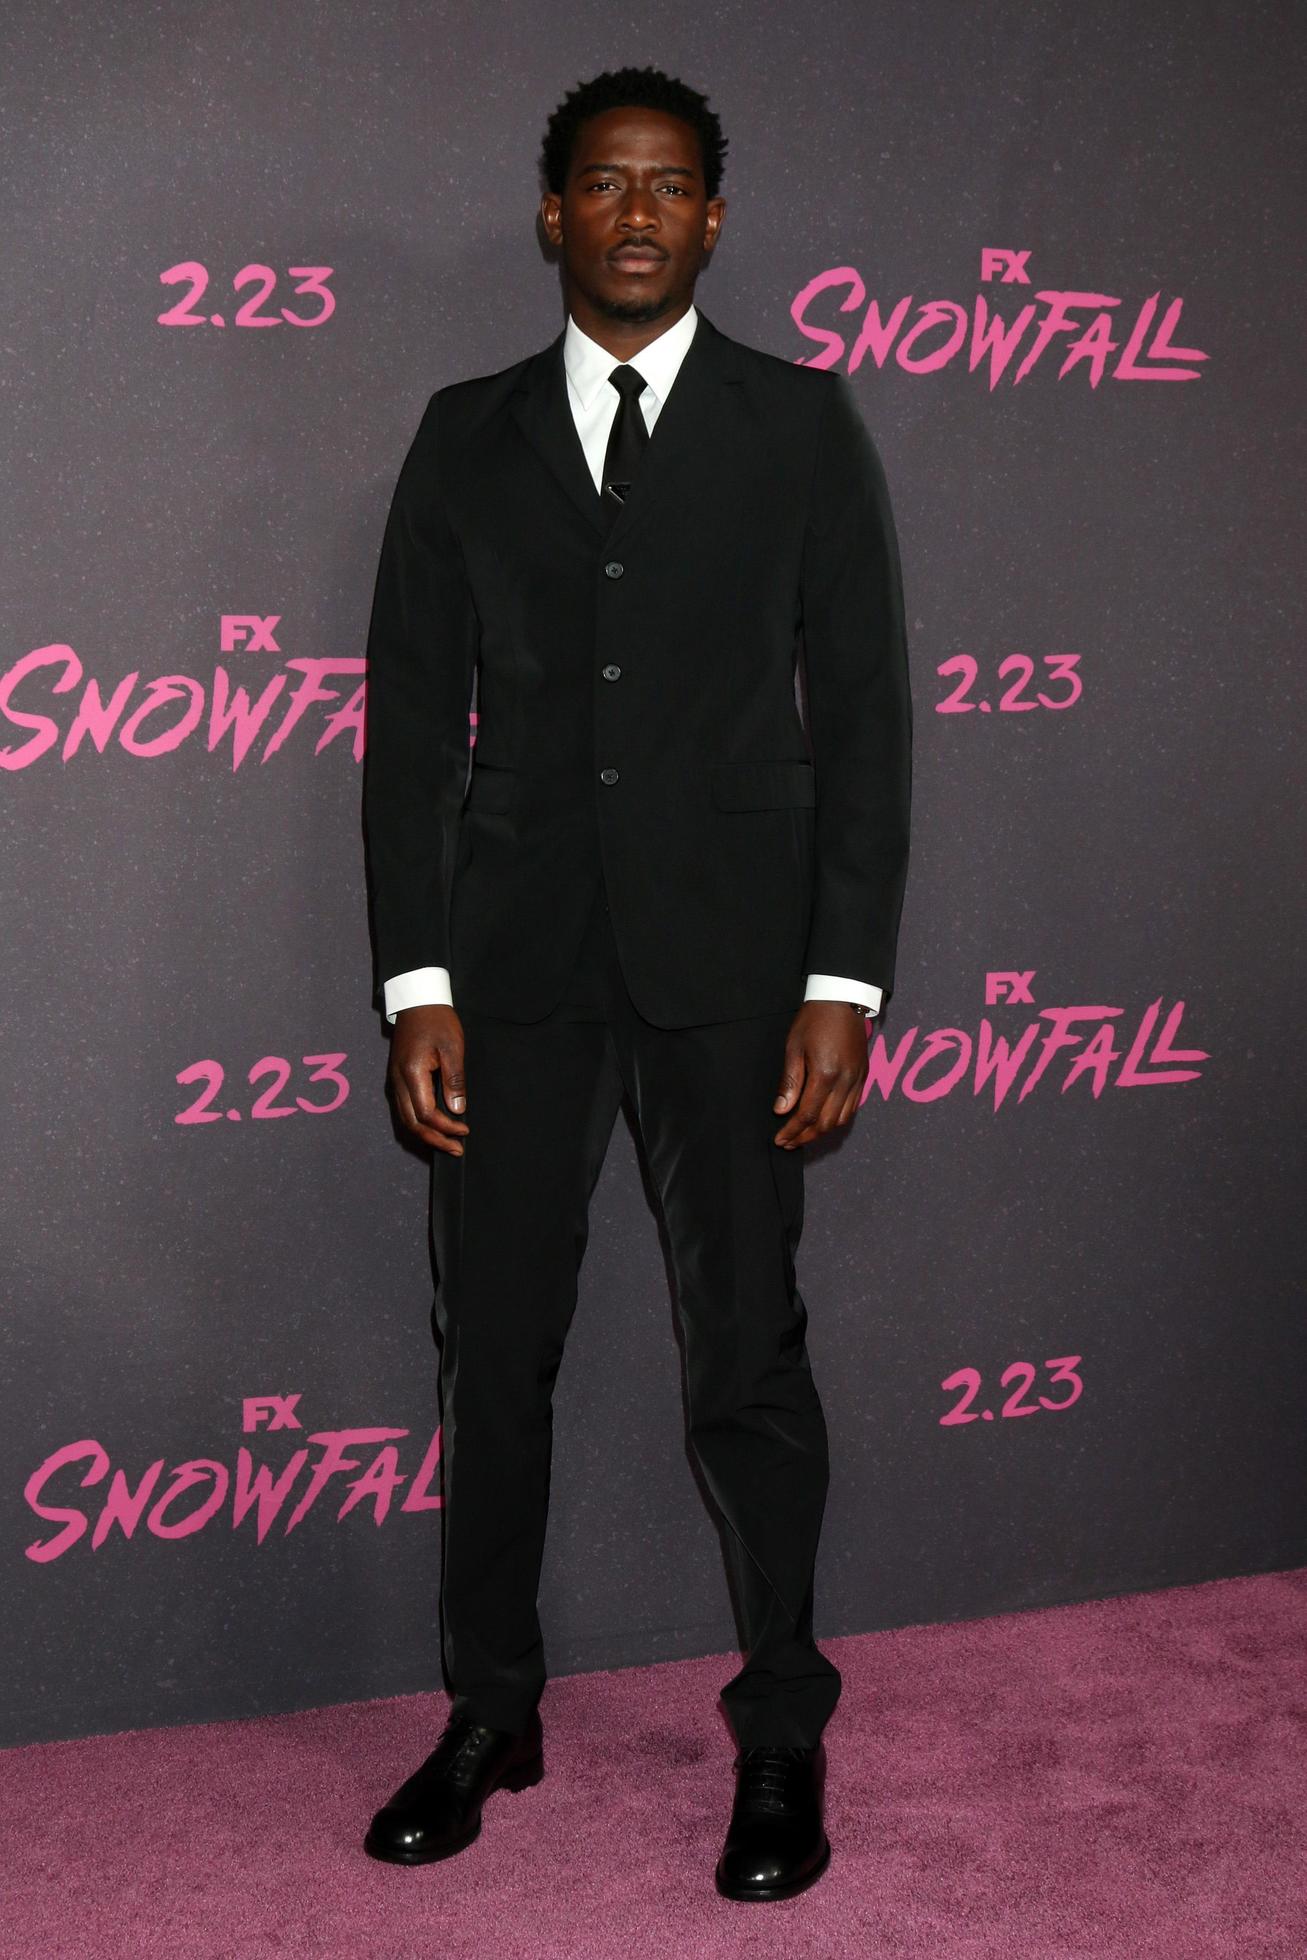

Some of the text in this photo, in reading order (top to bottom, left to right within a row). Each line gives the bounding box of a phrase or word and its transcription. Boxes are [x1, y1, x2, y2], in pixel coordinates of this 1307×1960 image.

[157, 260, 337, 329] 2.23
[980, 247, 1032, 285] FX
[789, 266, 1211, 392] SNOWFALL
[220, 614, 282, 652] FX
[0, 643, 370, 774] SNOWFA
[935, 653, 1084, 715] 2.23
[984, 970, 1037, 1006] FX
[174, 1052, 350, 1126] 2.23
[859, 996, 1212, 1113] NOWFALL
[242, 1394, 303, 1433] FX
[938, 1354, 1084, 1427] 2.23
[24, 1425, 446, 1564] SNOWFAL
